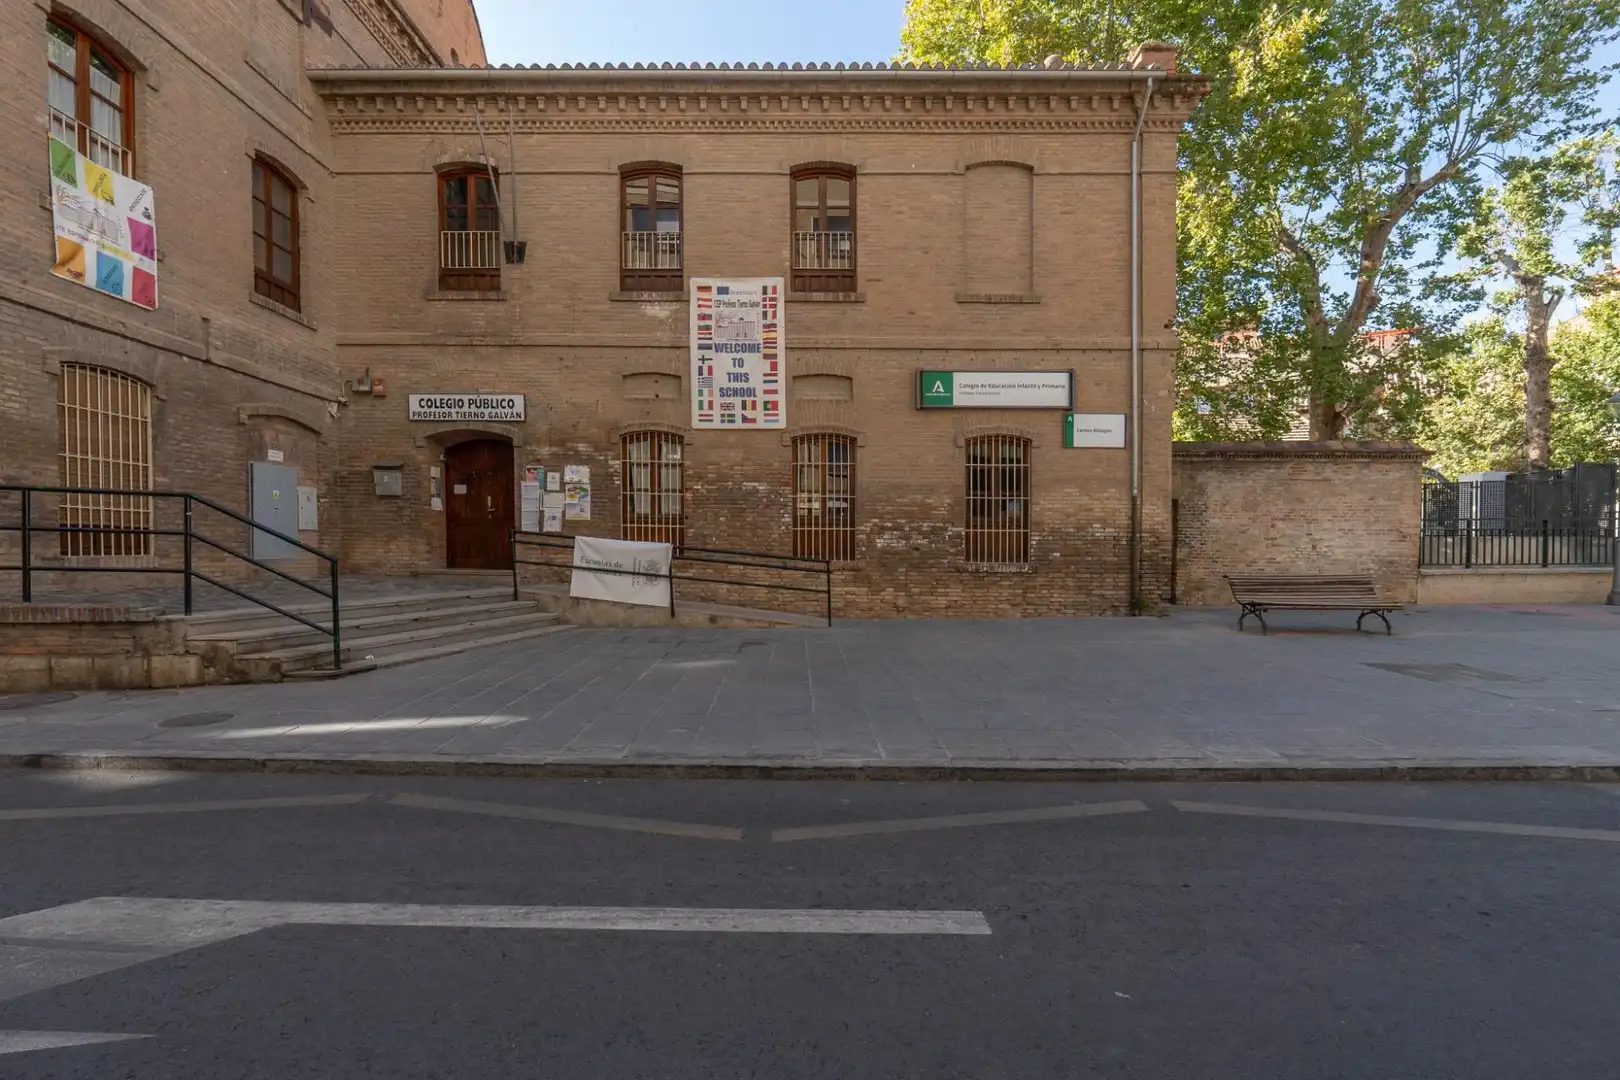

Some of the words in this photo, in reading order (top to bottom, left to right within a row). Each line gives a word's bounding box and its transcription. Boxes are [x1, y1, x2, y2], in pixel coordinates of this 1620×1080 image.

[714, 342, 762, 353] WELCOME
[731, 357, 744, 368] TO
[726, 372, 750, 383] THIS
[718, 386, 758, 398] SCHOOL
[418, 398, 464, 409] COLEGIO
[468, 396, 515, 409] PÚBLICO
[488, 410, 522, 419] GALVÁN
[580, 556, 613, 568] Escuelas
[614, 560, 622, 568] de
